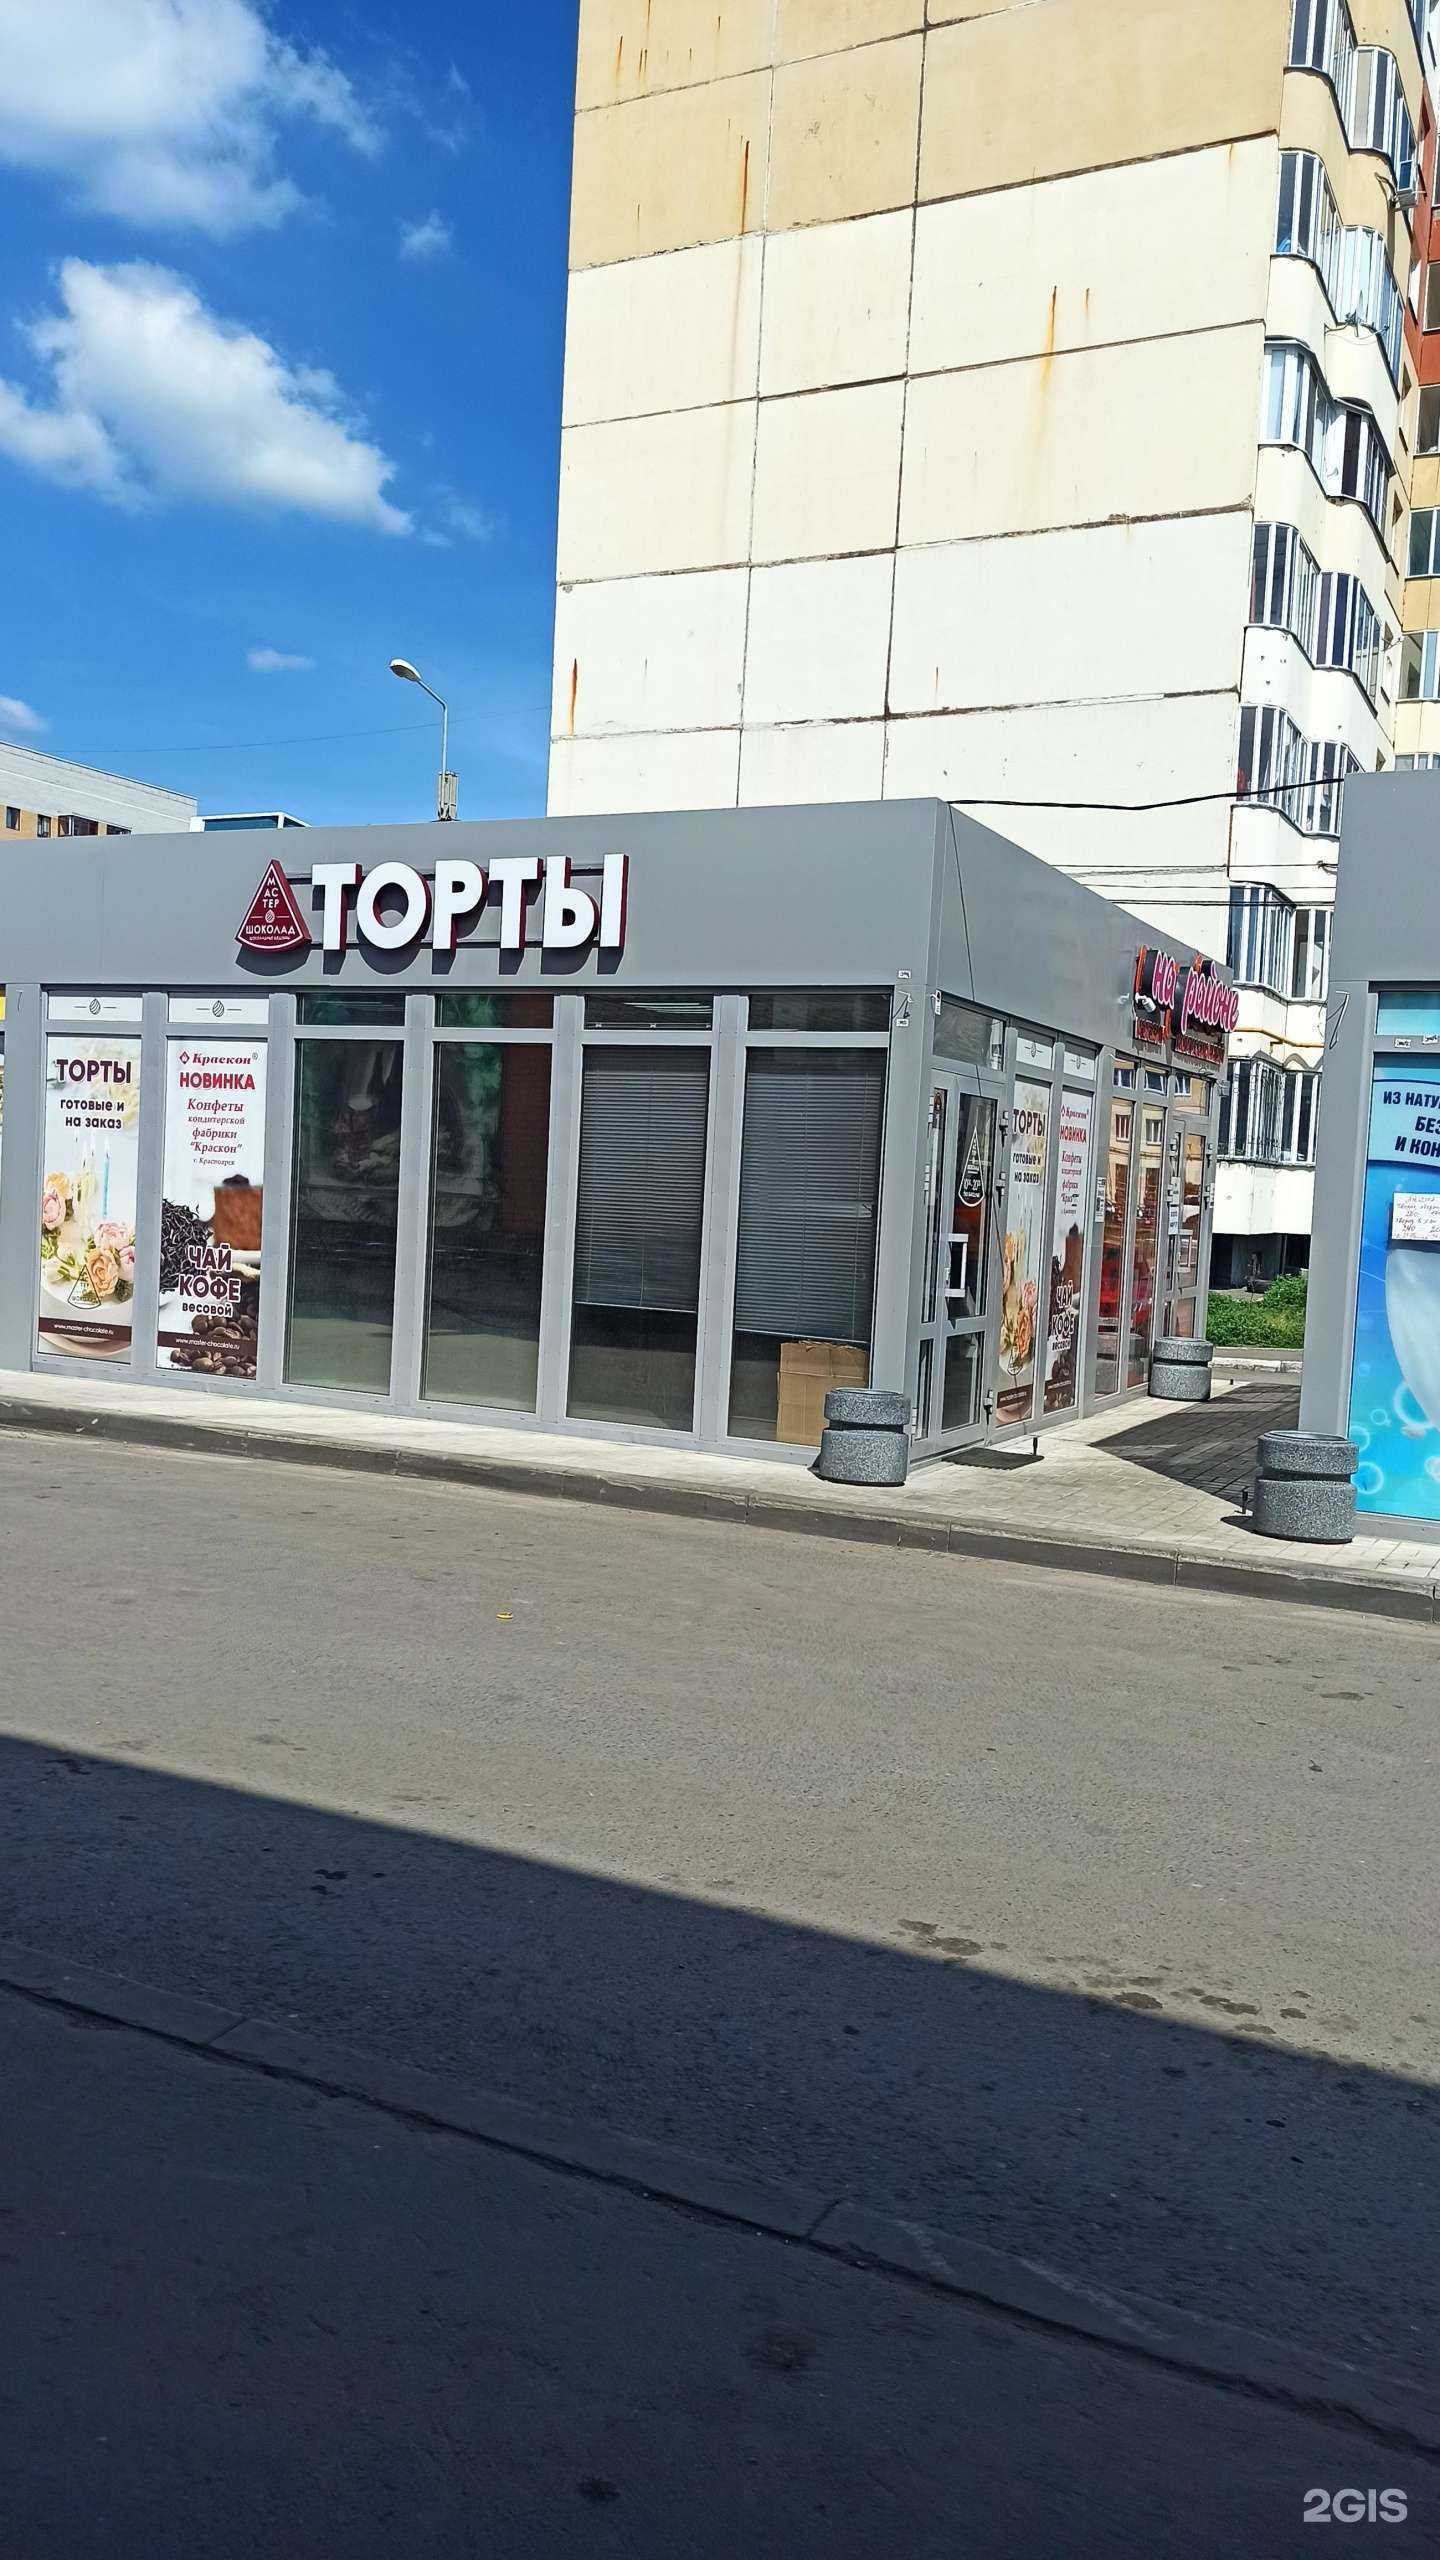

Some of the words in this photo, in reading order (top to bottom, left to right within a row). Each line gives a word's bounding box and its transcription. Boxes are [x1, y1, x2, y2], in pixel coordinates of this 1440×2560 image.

[267, 877, 276, 886] М
[264, 887, 279, 898] АС
[262, 899, 280, 909] ТЕР
[311, 853, 629, 950] ТОРТЫ
[245, 924, 296, 935] ШОКОЛАД
[56, 1058, 132, 1084] ТОРТЫ
[179, 1071, 256, 1090] НОВИНКА
[60, 1099, 113, 1112] готовые
[116, 1101, 125, 1112] и
[187, 1098, 245, 1115] Конфеты
[1383, 1090, 1401, 1105] ИЗ
[1405, 1092, 1440, 1109] НАТУ
[65, 1116, 82, 1127] на
[85, 1116, 122, 1130] заказ
[188, 1115, 246, 1126] кондитерской
[1013, 1108, 1046, 1137] ТОРТЫ
[192, 1127, 238, 1141] фабрики
[1060, 1125, 1087, 1142] НОВИНКА
[1394, 1136, 1407, 1152] И
[1409, 1138, 1440, 1158] КОН
[1013, 1153, 1036, 1166] готовые
[1014, 1171, 1022, 1183] на
[1023, 1171, 1039, 1184] заказ
[188, 1244, 232, 1272] ЧАЙ
[179, 1275, 240, 1302] КОФЕ
[1057, 1281, 1073, 1308] ЧАЙ
[182, 1303, 232, 1317] весовой
[1052, 1314, 1075, 1336] КОФЕ
